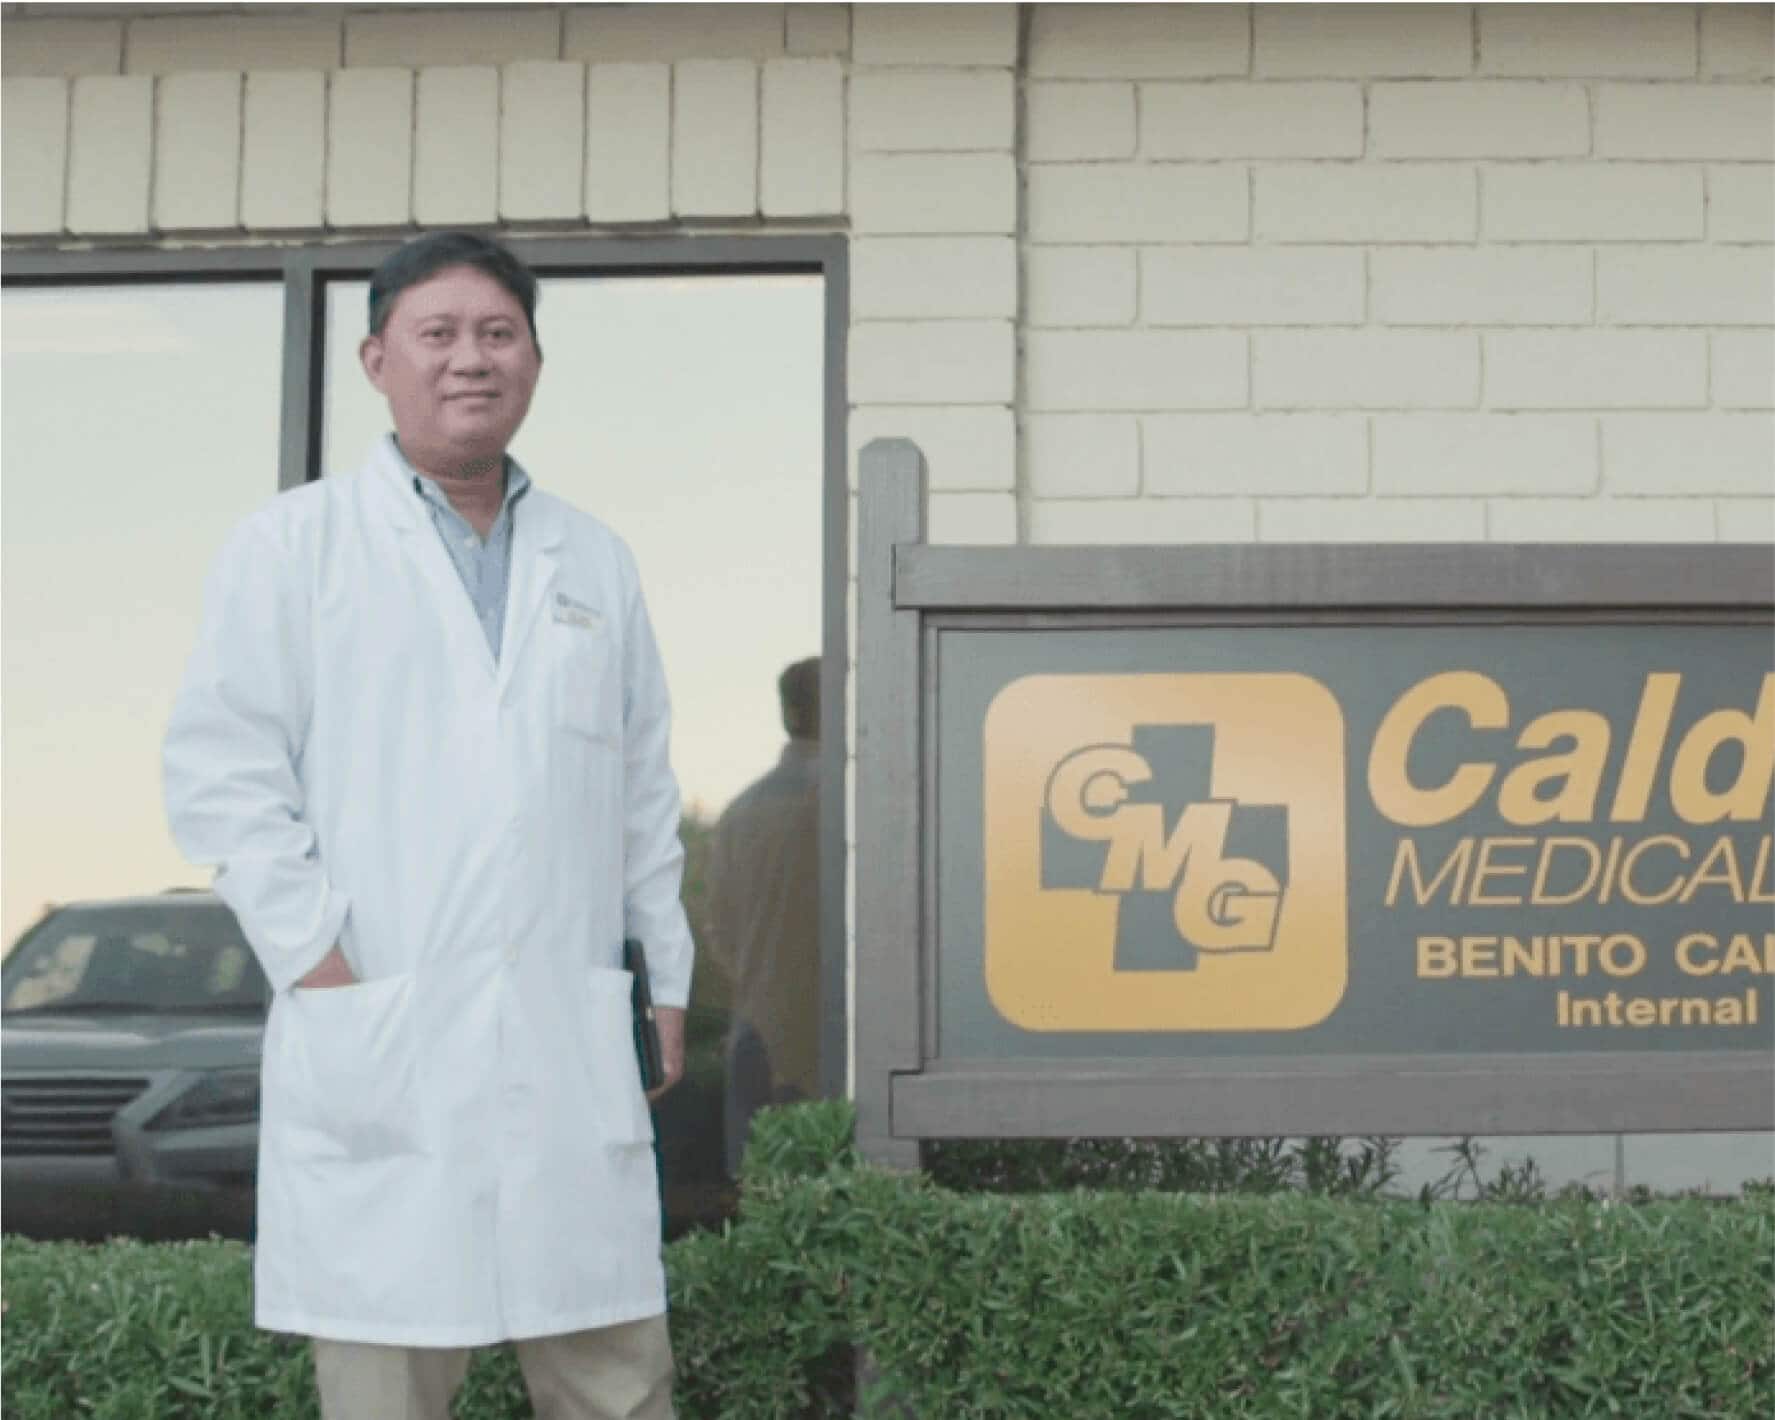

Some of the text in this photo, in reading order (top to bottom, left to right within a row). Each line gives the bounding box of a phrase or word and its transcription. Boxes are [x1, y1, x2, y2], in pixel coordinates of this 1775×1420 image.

[1368, 671, 1775, 826] Cald
[1044, 742, 1285, 954] CMG
[1387, 834, 1775, 904] MEDICAL
[1416, 933, 1648, 978] BENITO
[1557, 988, 1760, 1027] Internal
